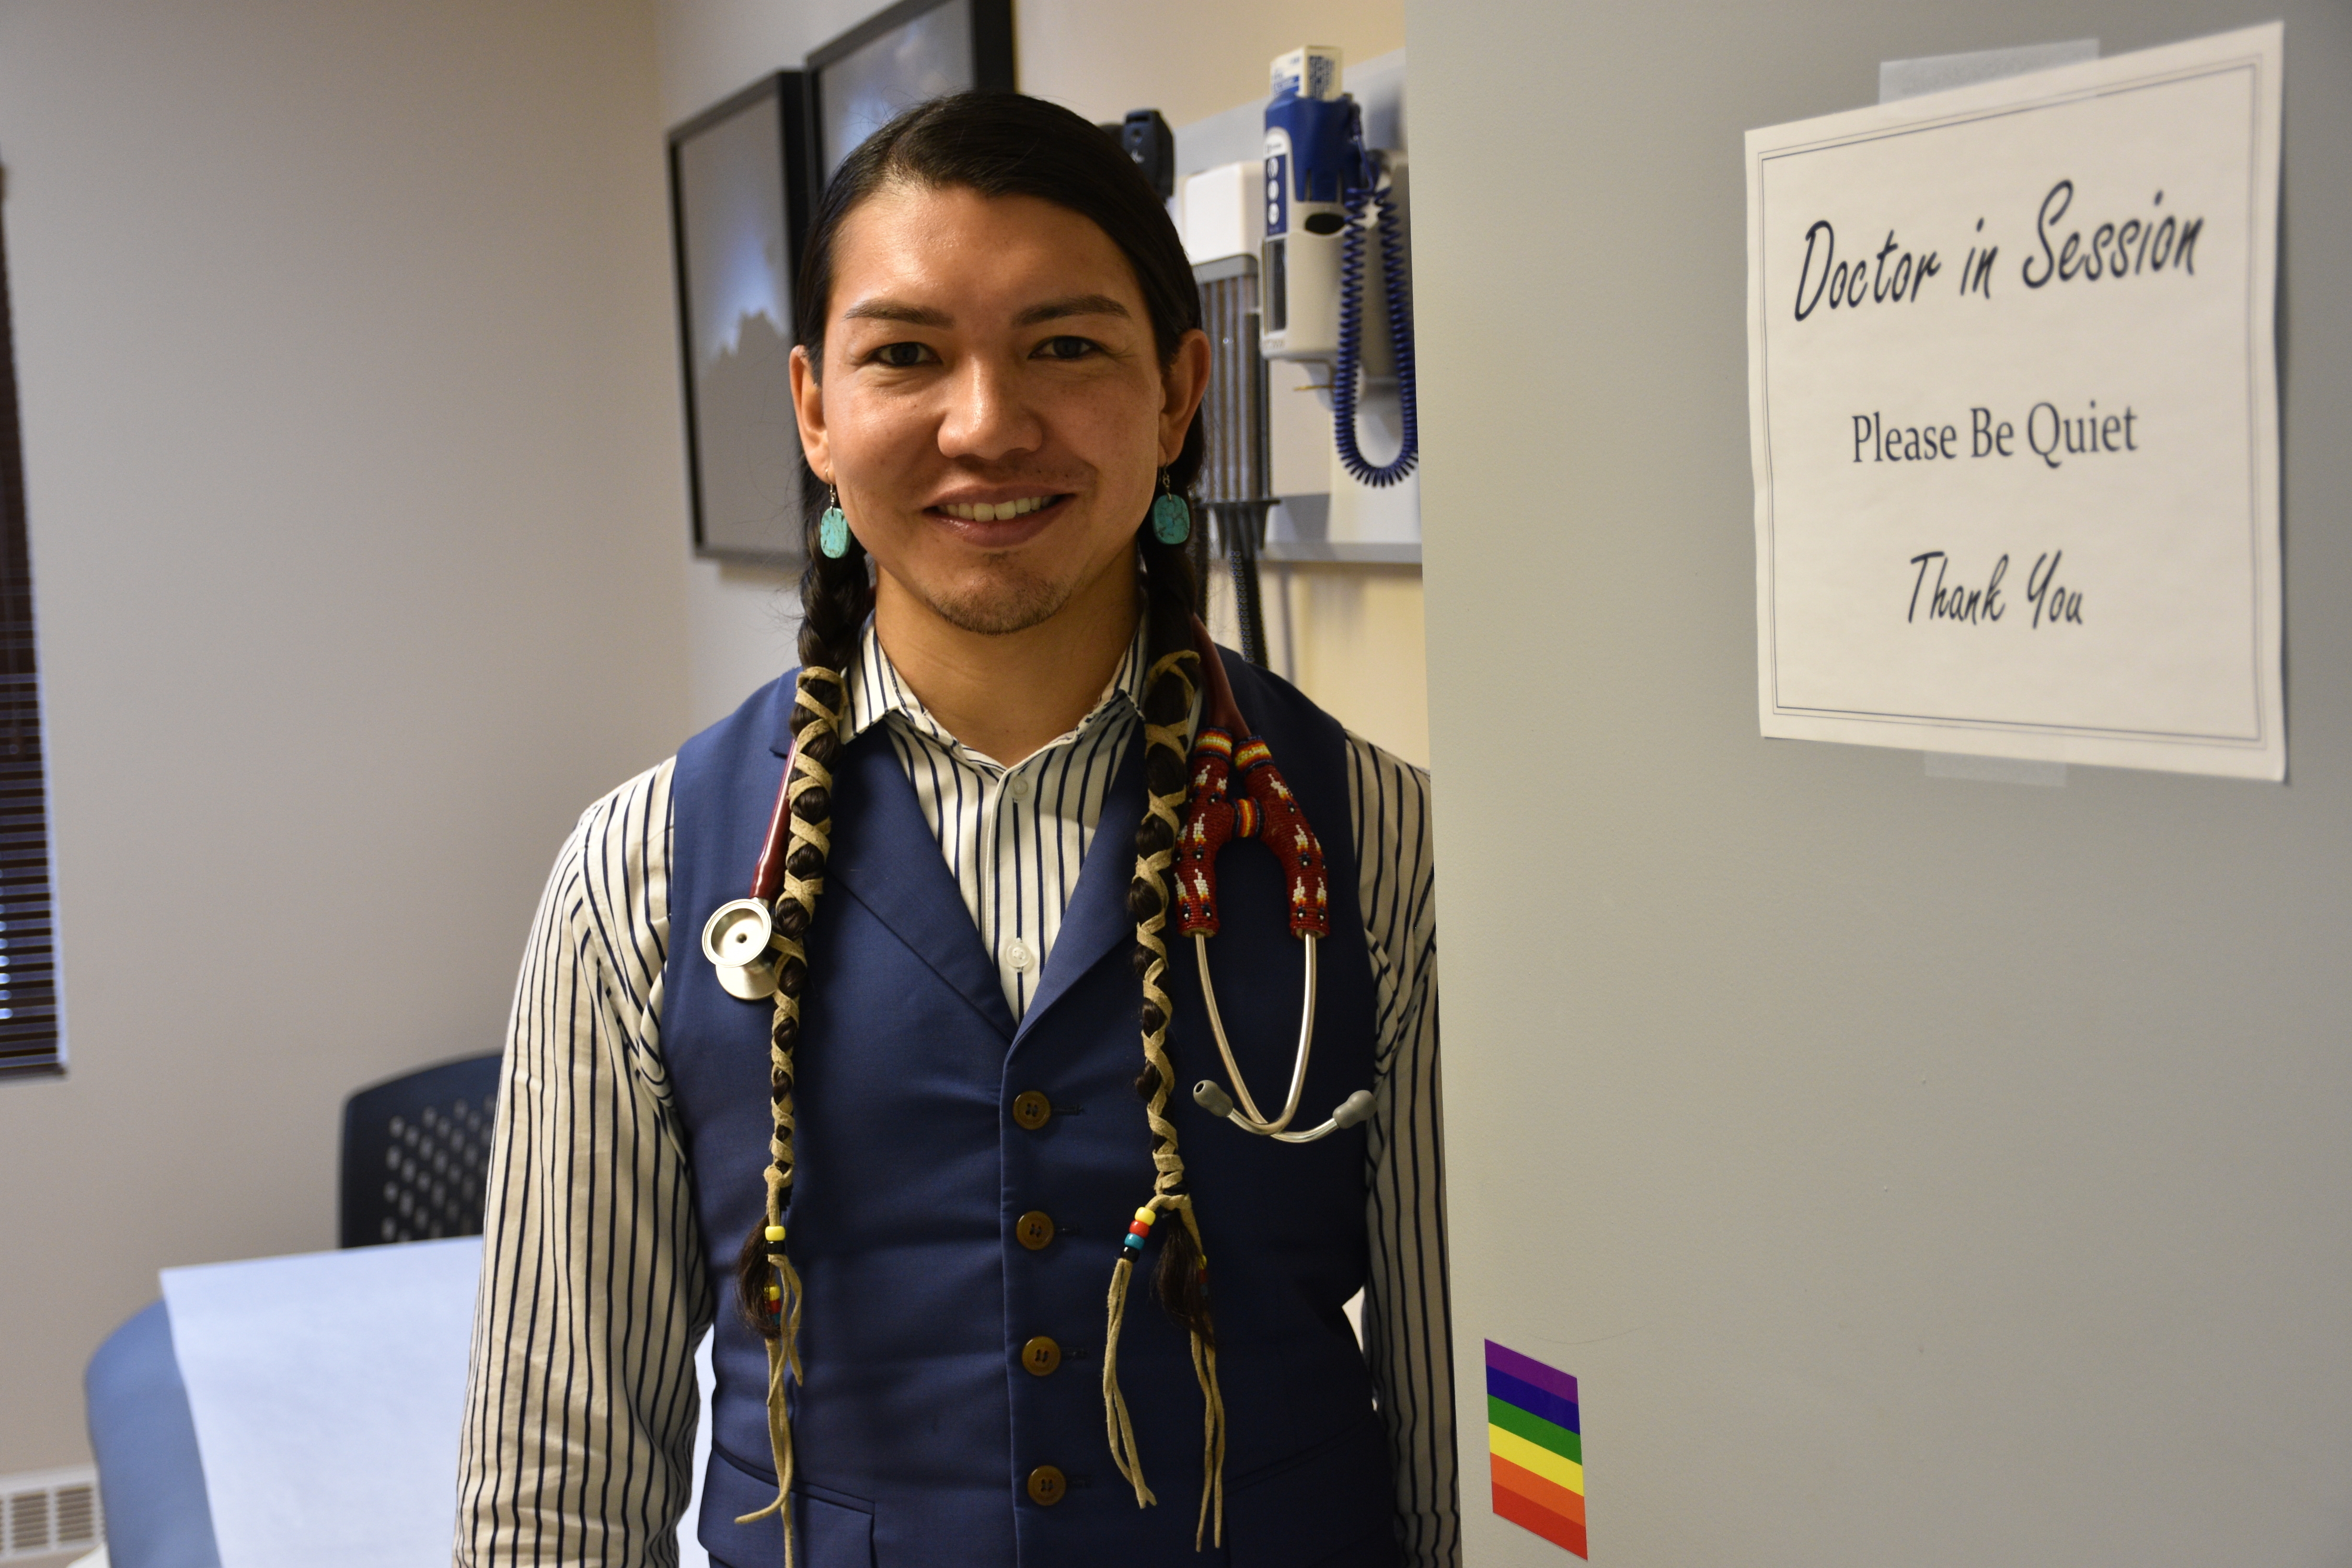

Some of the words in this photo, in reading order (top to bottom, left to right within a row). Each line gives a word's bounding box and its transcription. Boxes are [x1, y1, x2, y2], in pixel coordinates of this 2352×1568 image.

[1794, 220, 1942, 322] Doctor
[1959, 217, 1999, 300] in
[2021, 179, 2204, 290] Session
[1851, 411, 1957, 463] Please
[1970, 407, 2014, 458] Be
[2027, 400, 2138, 470] Quiet
[1907, 550, 2010, 626] Thank
[2026, 549, 2083, 630] You
